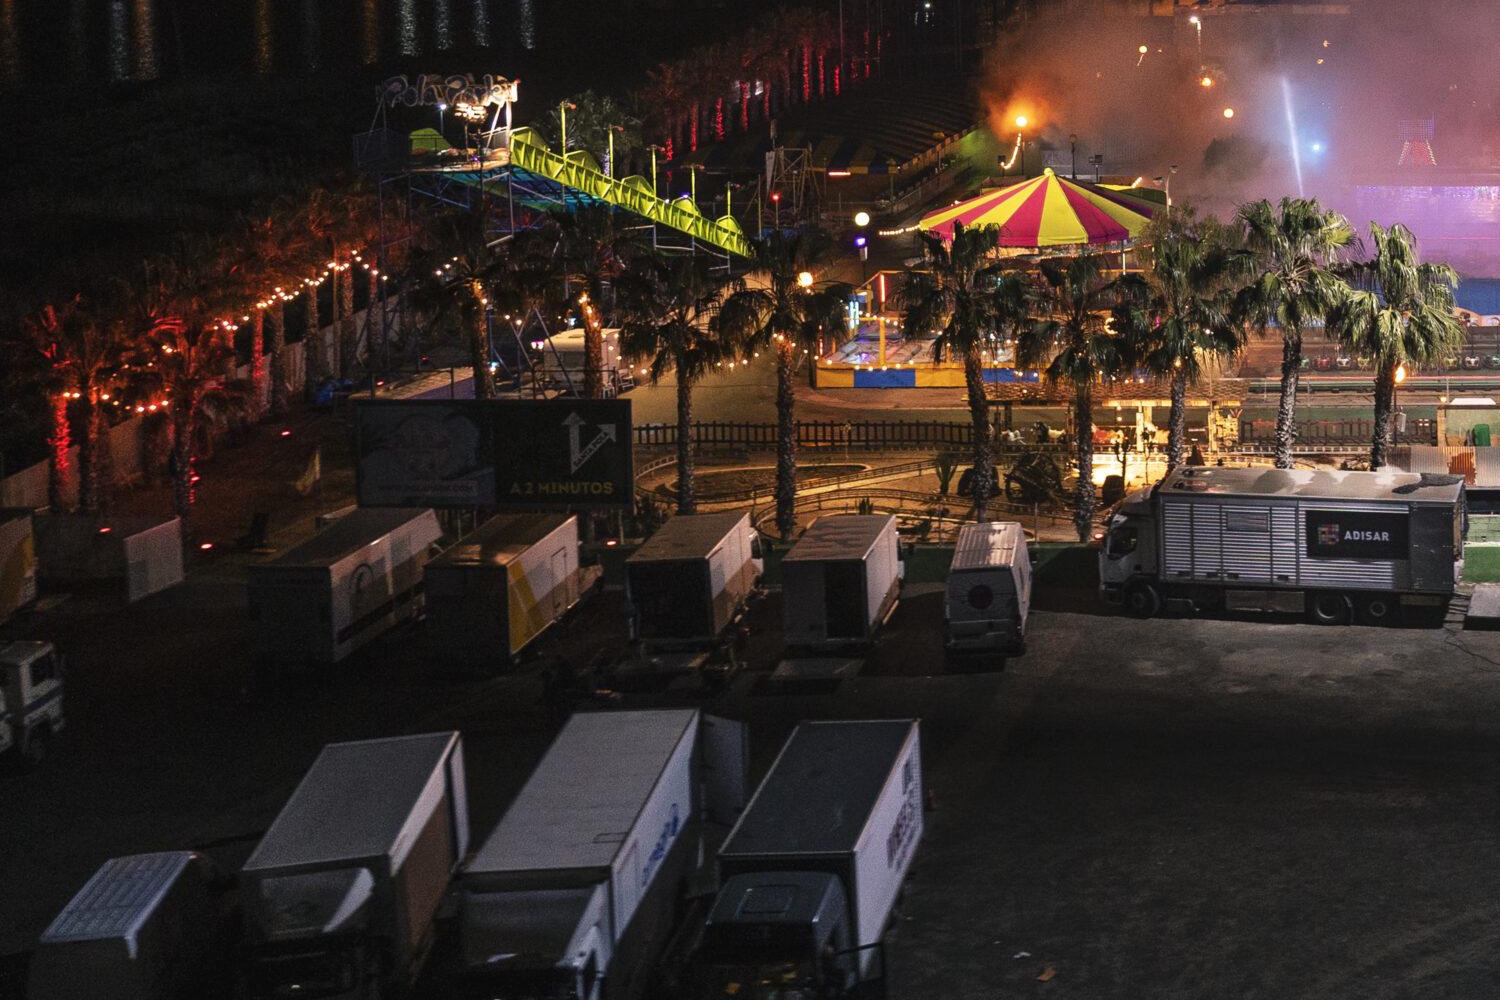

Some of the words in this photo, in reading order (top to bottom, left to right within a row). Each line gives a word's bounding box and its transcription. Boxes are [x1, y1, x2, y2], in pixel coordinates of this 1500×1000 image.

[510, 482, 522, 495] A
[526, 481, 534, 495] 2
[538, 481, 614, 495] MINUTOS
[1343, 530, 1389, 541] ADISAR
